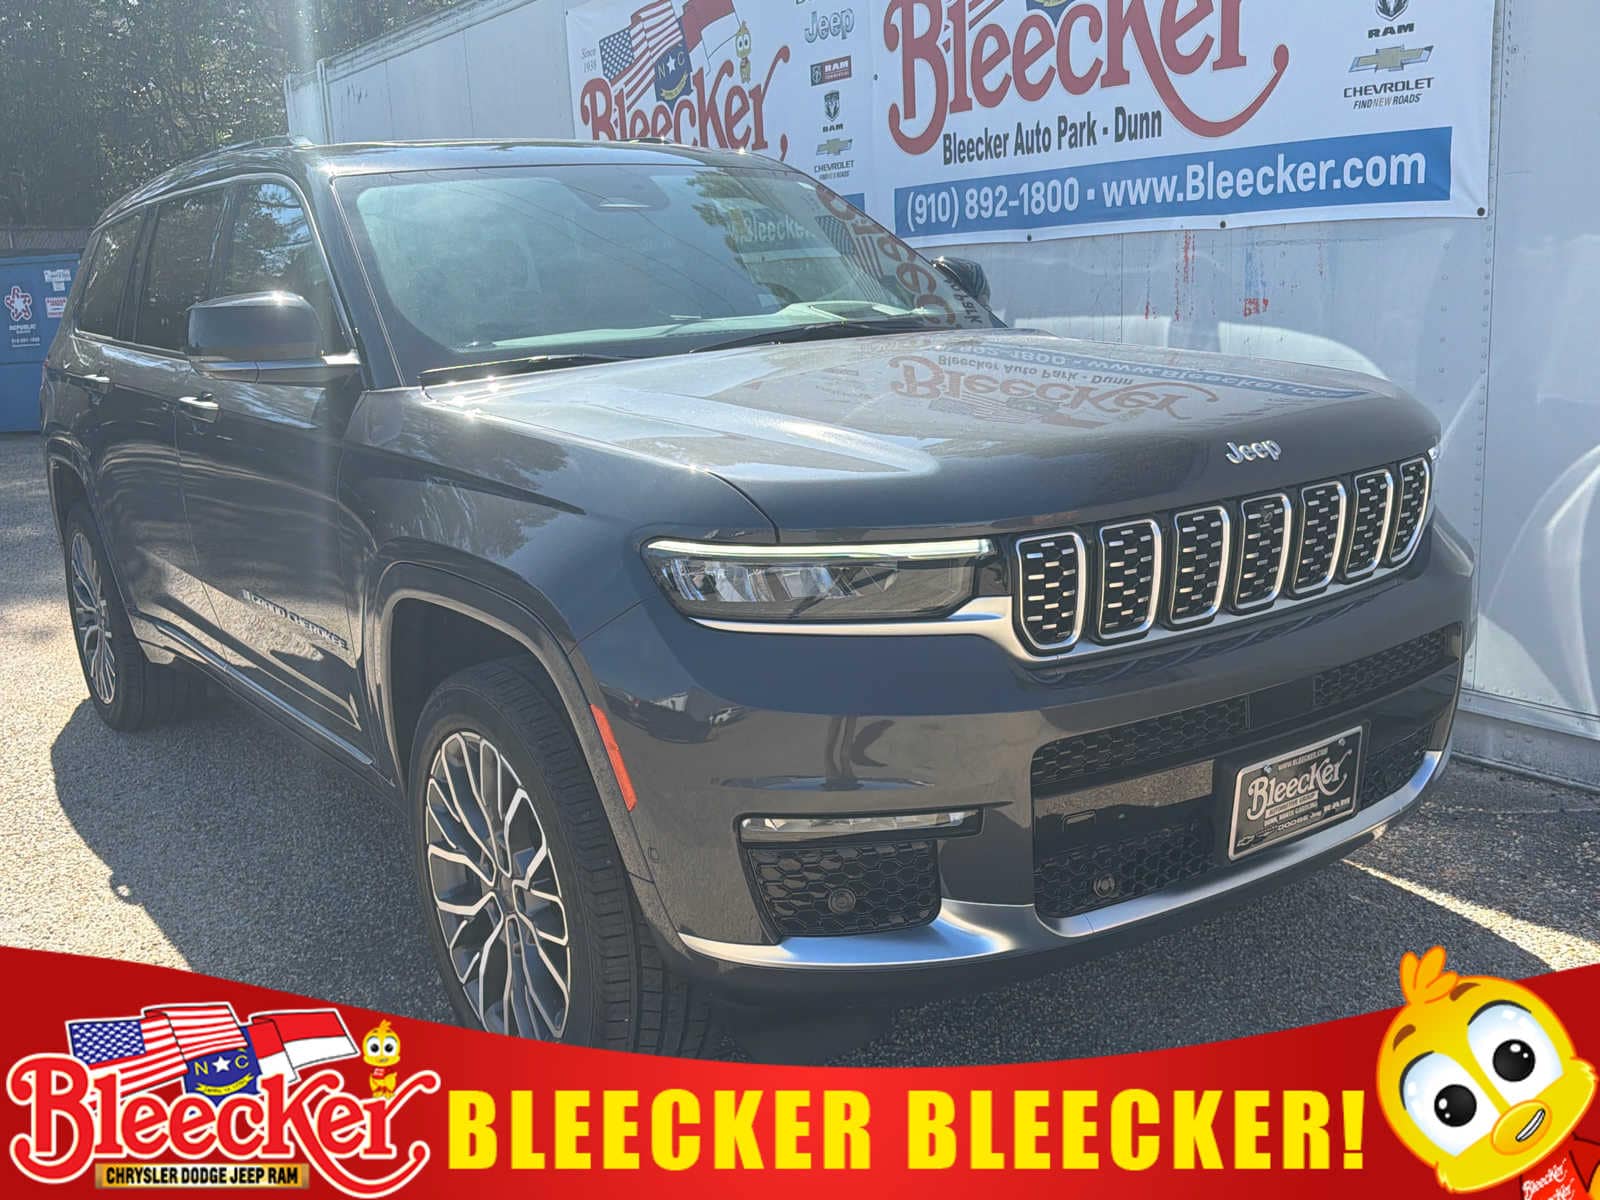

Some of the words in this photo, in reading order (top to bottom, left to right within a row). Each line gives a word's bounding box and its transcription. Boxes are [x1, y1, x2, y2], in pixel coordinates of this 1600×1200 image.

[804, 8, 855, 43] Jeep
[1367, 23, 1415, 38] RAM
[824, 60, 849, 73] RAM
[883, 0, 1289, 155] Bleecker
[1343, 77, 1434, 98] CHEVROLET
[580, 46, 790, 161] Bleecker
[822, 123, 844, 133] RAM
[943, 127, 1009, 165] Bleecker
[1014, 120, 1051, 157] Auto
[1057, 111, 1097, 150] Park
[1114, 106, 1162, 143] Dunn
[814, 160, 854, 173] CHEVROLET
[907, 184, 959, 232] (910)
[965, 176, 1079, 220] 892-1800
[1102, 152, 1426, 208] www.Bleecker.com
[1226, 440, 1281, 464] Jeep
[1247, 749, 1353, 821] Bleecker
